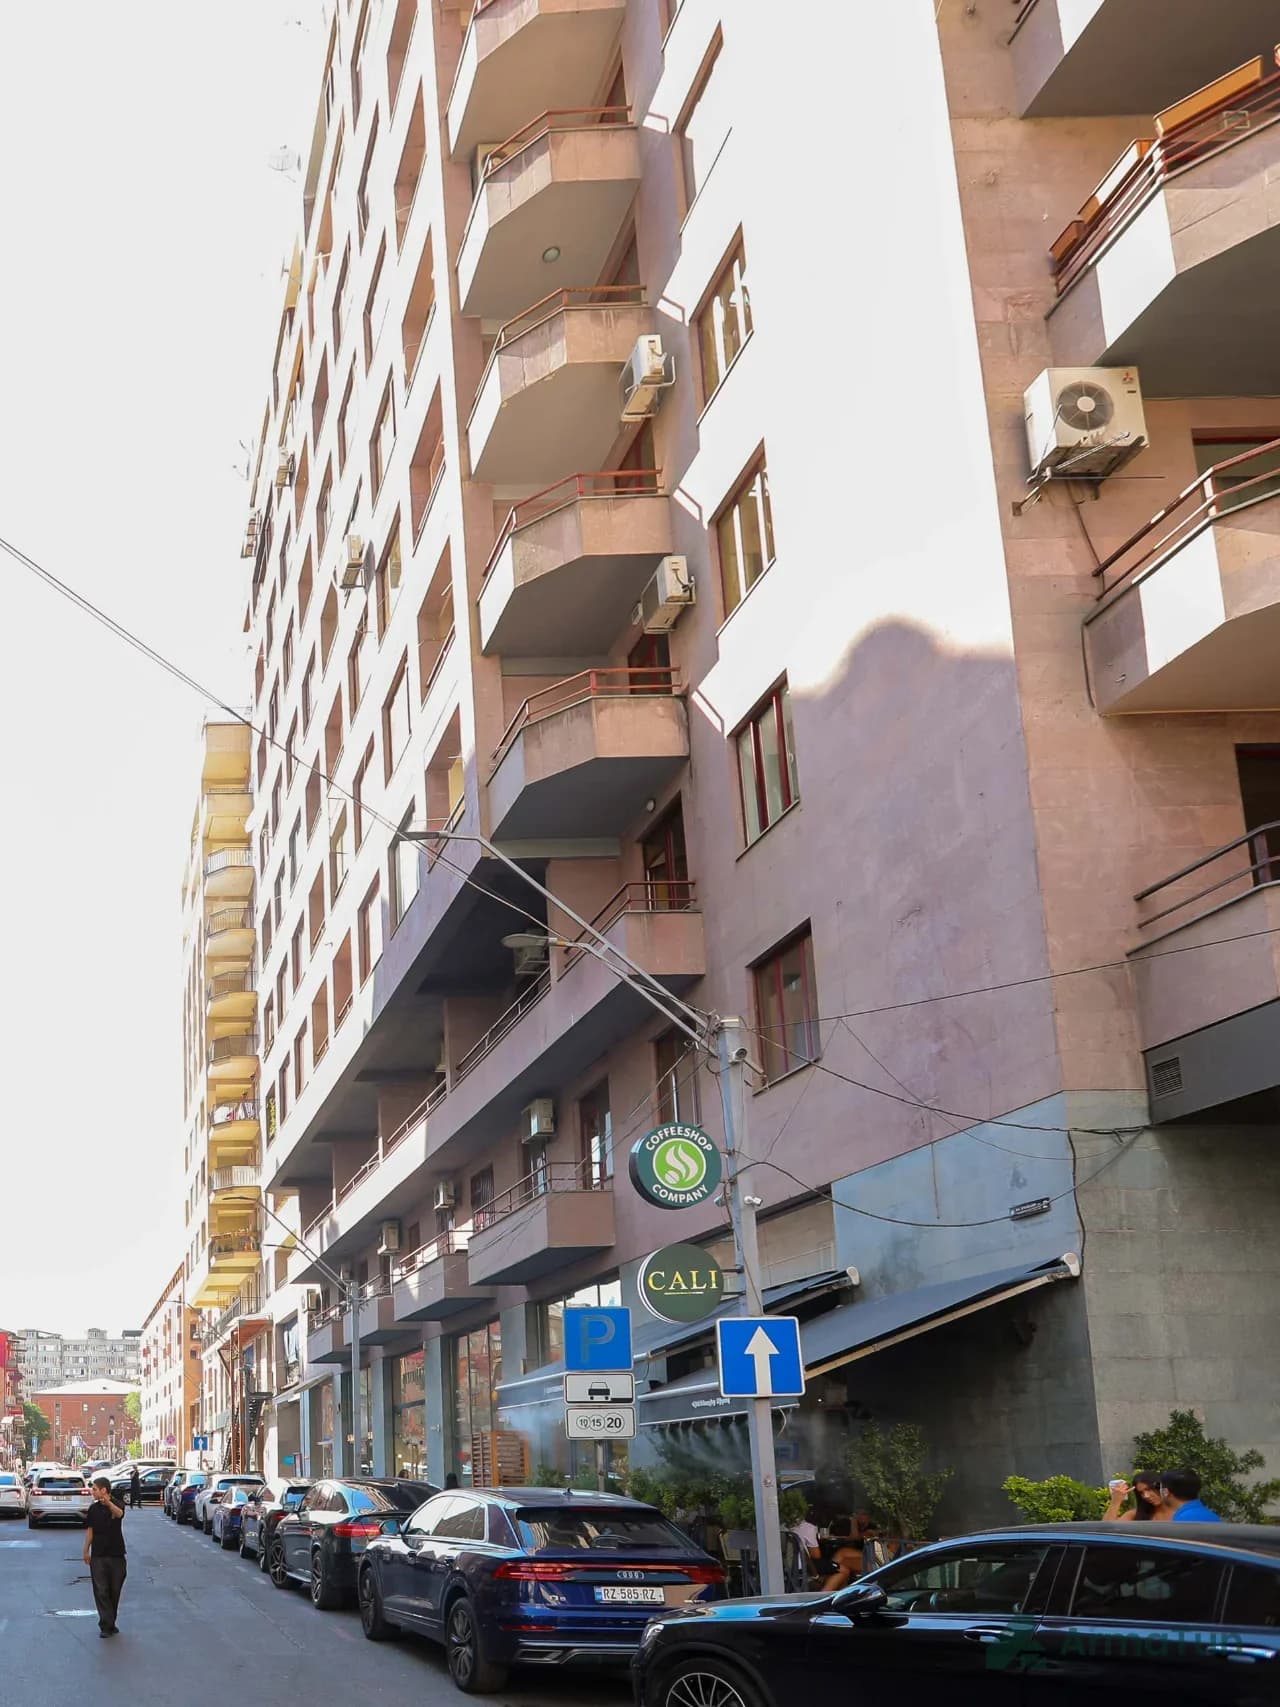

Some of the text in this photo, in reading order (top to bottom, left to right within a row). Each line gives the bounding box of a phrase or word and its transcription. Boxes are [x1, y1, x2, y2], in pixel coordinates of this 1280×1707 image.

[646, 1126, 713, 1151] COFFEESHOP
[652, 1184, 708, 1203] COMPANY
[648, 1270, 719, 1291] CALI
[581, 1314, 616, 1363] P
[592, 1418, 602, 1427] 15
[606, 1417, 622, 1429] 20
